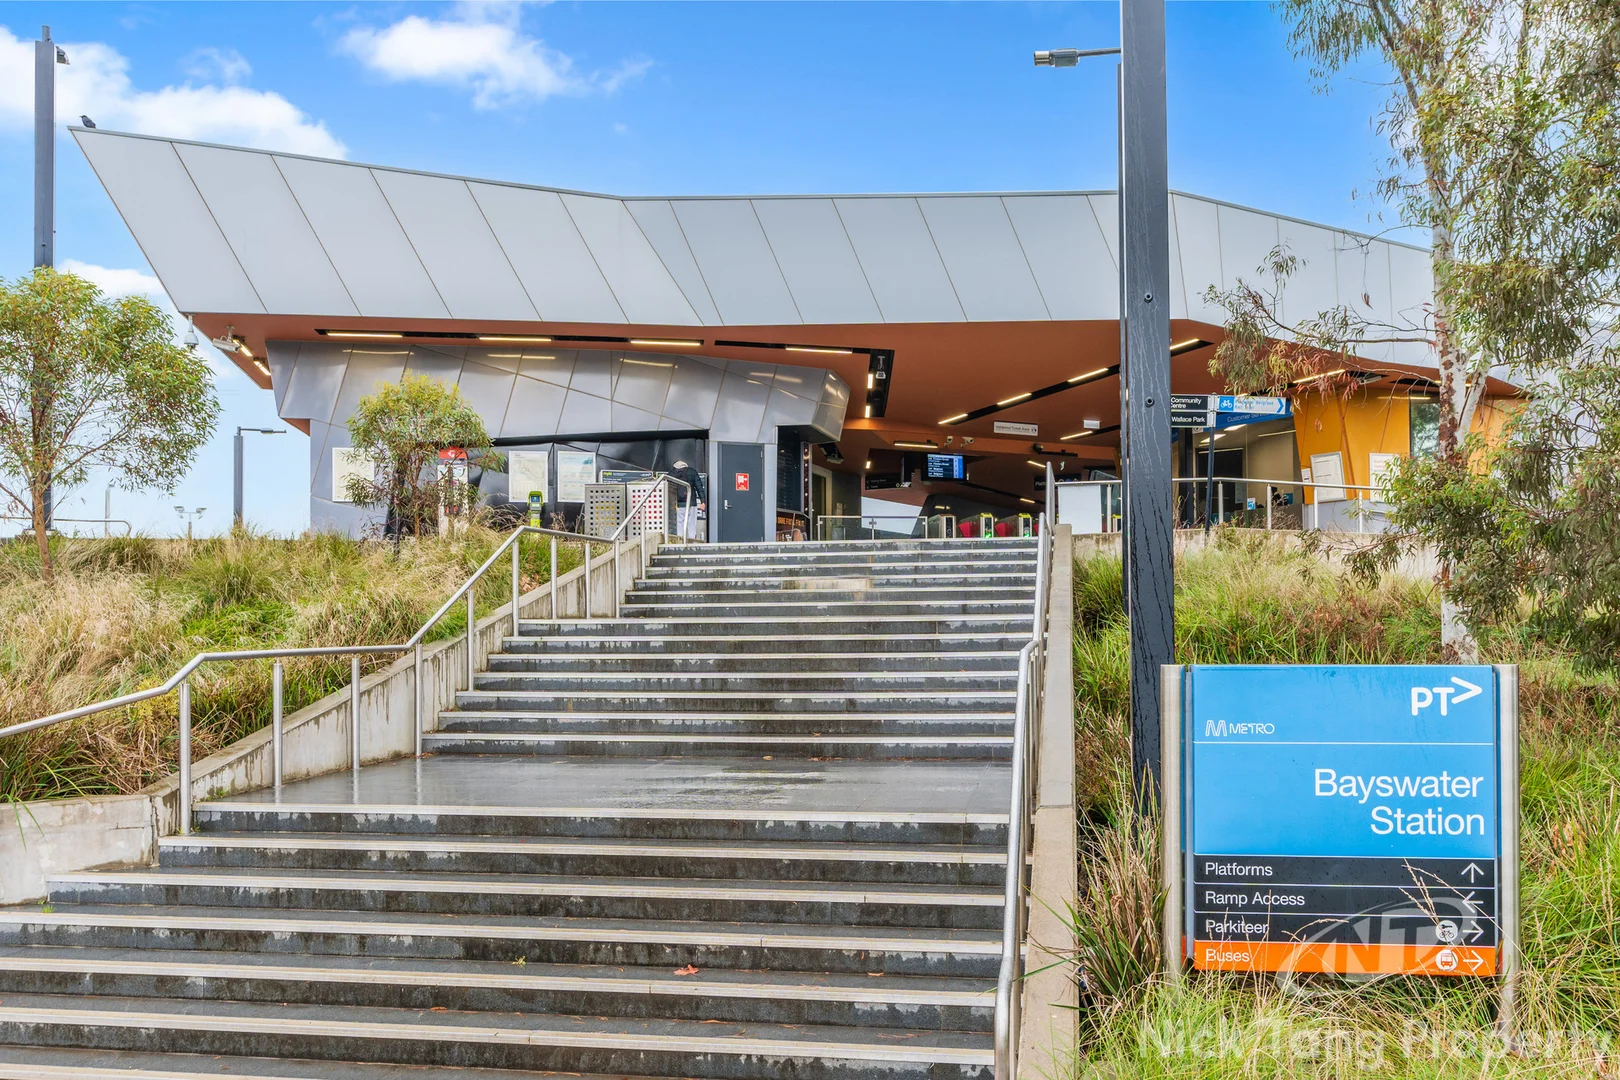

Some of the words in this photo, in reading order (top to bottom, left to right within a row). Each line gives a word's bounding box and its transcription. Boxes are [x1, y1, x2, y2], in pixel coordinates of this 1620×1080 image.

[1171, 397, 1202, 405] Community
[1227, 414, 1251, 423] Customer
[1229, 723, 1275, 735] METRO
[1314, 768, 1484, 804] Bayswater
[1370, 805, 1485, 836] Station
[1205, 862, 1273, 876] Platforms
[1205, 891, 1248, 907] Ramp
[1251, 891, 1306, 906] Access
[1205, 919, 1269, 934] Parkiteer
[1205, 948, 1250, 963] Buses
